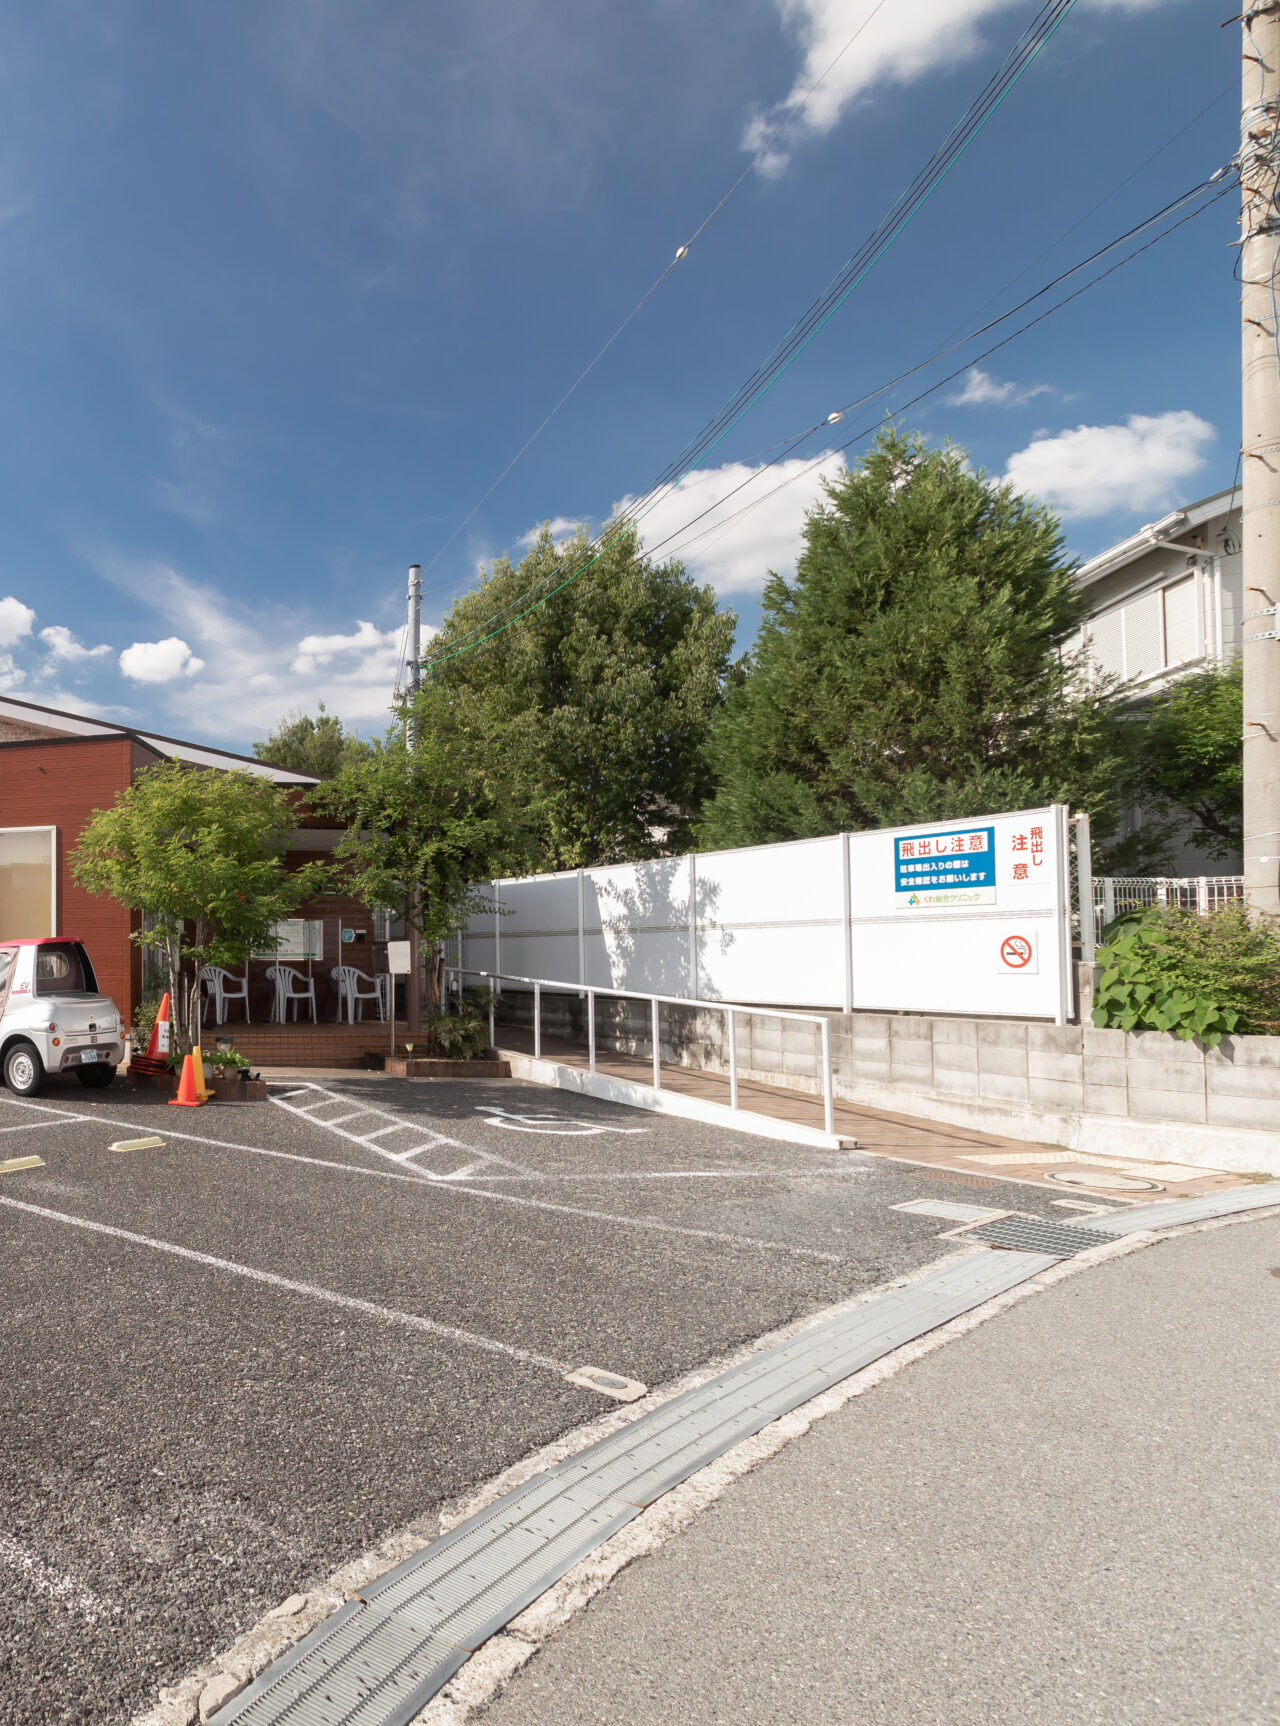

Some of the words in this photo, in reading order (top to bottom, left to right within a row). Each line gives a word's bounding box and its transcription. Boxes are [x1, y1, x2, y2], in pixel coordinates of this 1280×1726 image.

[901, 835, 984, 858] 飛出し注意
[1012, 834, 1029, 880] 注意
[1030, 826, 1043, 866] 飛出し
[900, 859, 969, 873] 駐車場出入りの際は
[900, 871, 987, 887] 安全確認をお願いします
